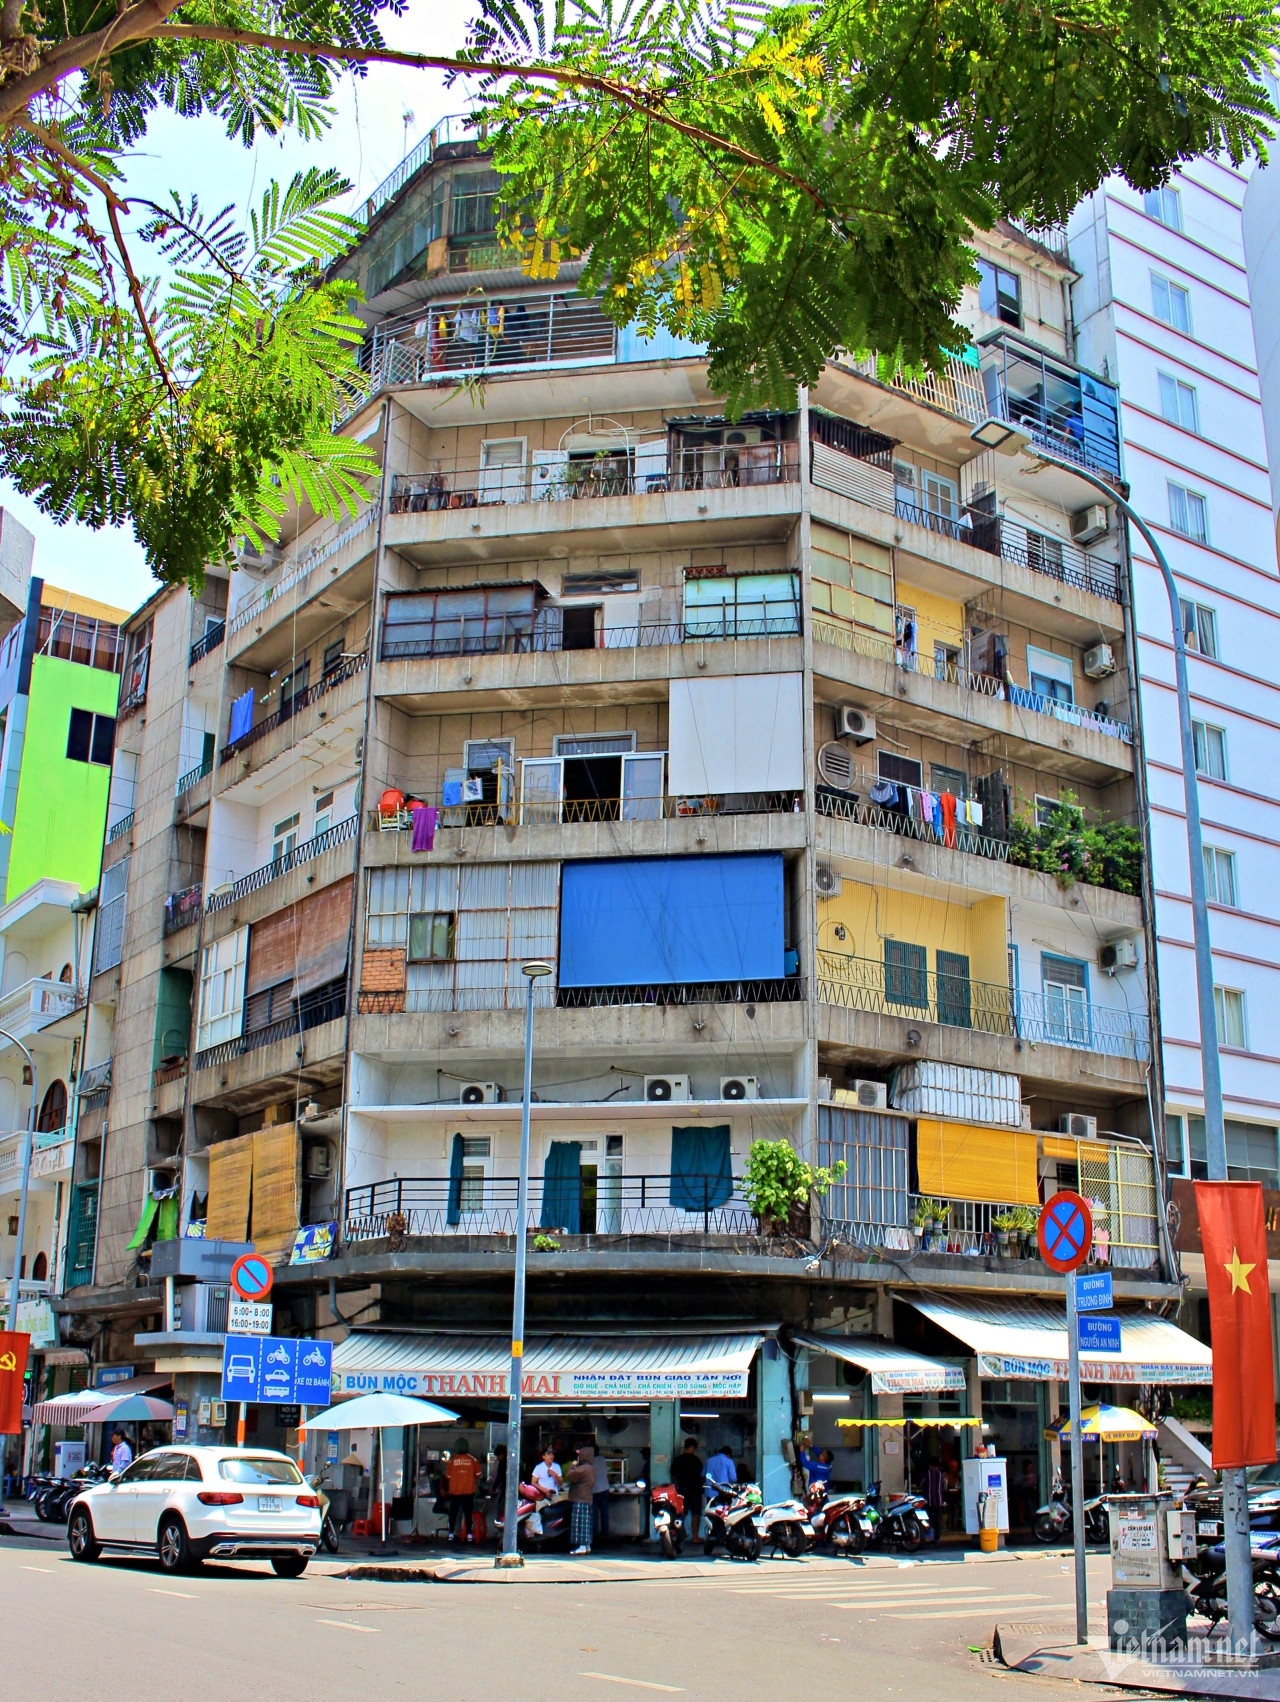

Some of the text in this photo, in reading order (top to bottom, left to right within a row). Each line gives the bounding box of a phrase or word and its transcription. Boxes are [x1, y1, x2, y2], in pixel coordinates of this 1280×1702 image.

[1098, 1294, 1112, 1306] ĐỊNH
[1088, 1321, 1112, 1332] ĐƯỜNG
[1100, 1337, 1107, 1348] AN
[1108, 1337, 1120, 1348] NINH
[1004, 1358, 1026, 1372] BÚN
[1028, 1360, 1050, 1377] MỘC
[1108, 1364, 1134, 1380] MAI
[313, 1377, 330, 1386] BÁNH
[346, 1372, 561, 1395] BÚN MỘC THANH MAI
[610, 1374, 632, 1382] ĐẶT
